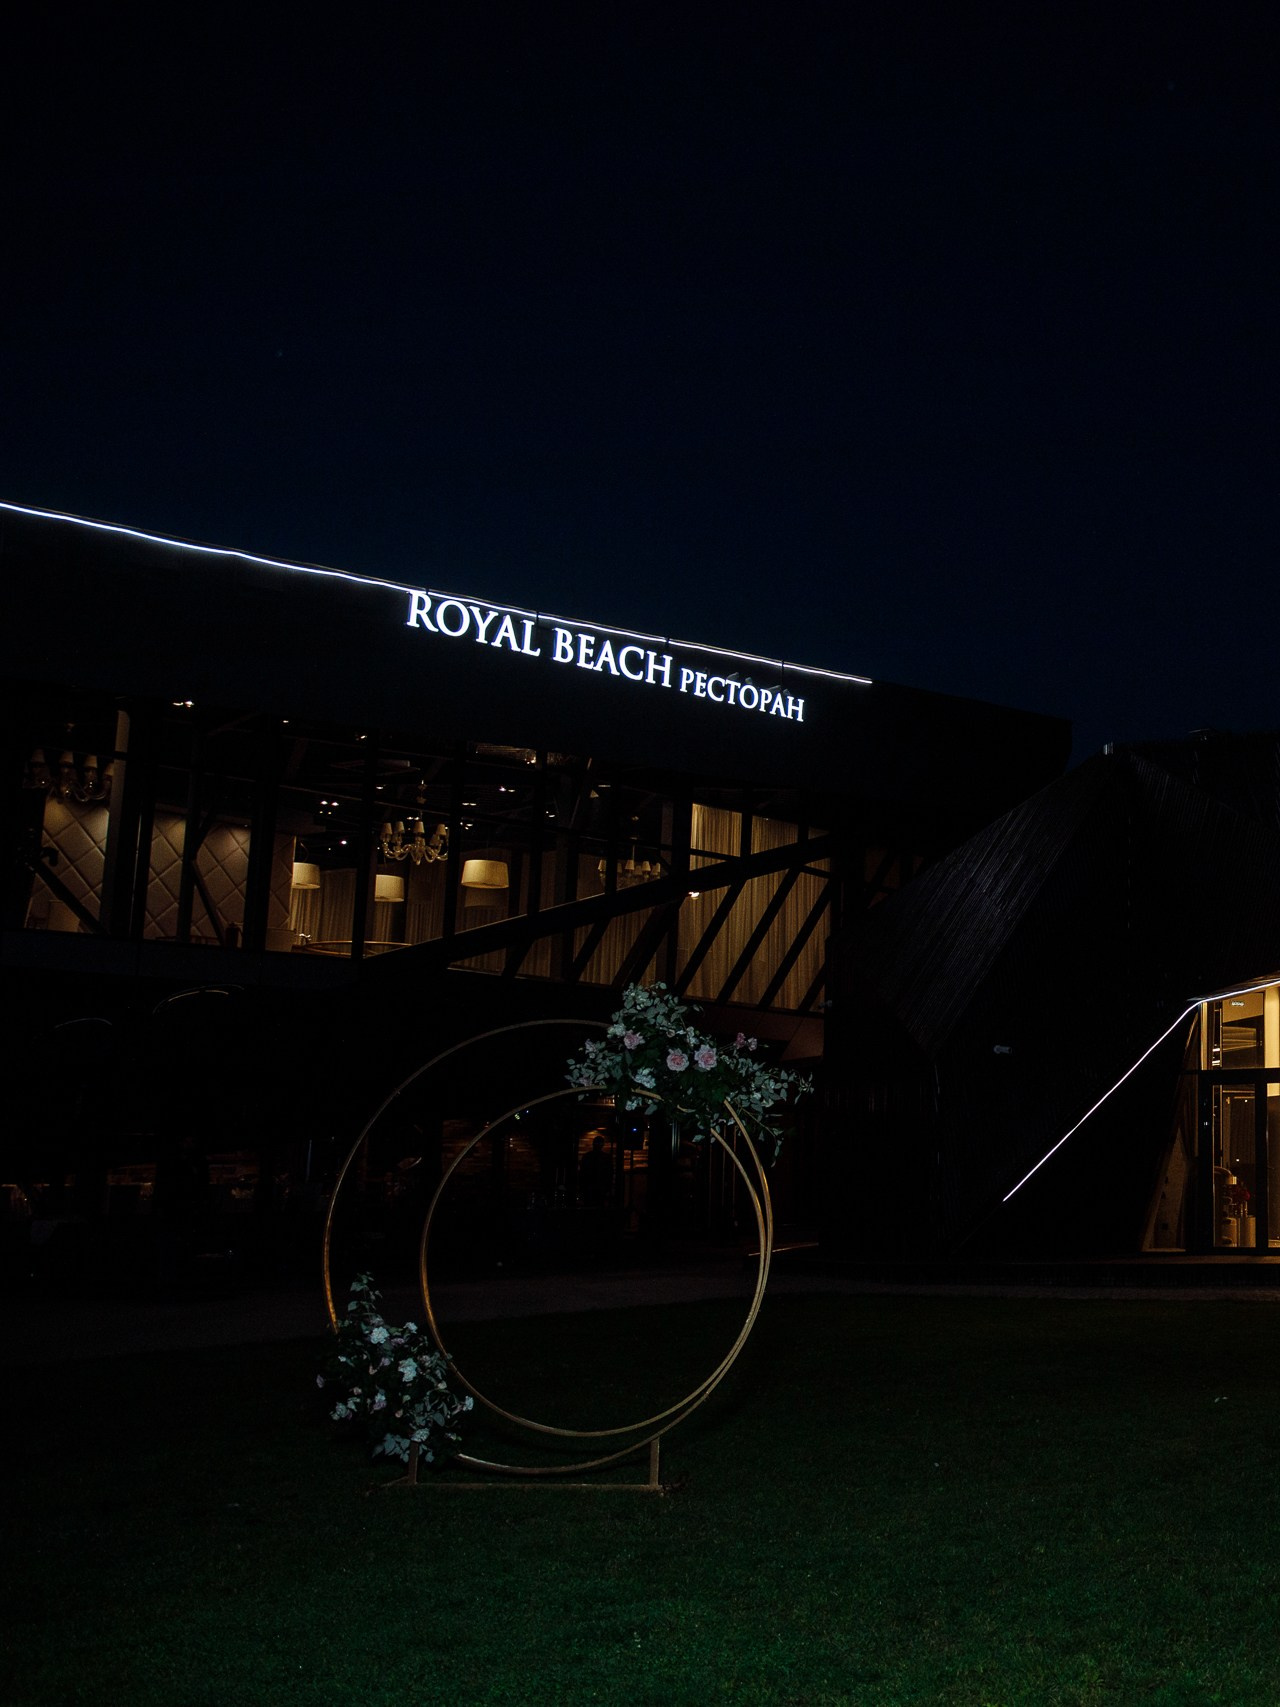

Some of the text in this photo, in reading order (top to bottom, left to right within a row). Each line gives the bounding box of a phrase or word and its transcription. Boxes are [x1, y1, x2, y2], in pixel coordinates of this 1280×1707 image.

[406, 591, 806, 723] ROYAL BEACH РЕСТОРАН
